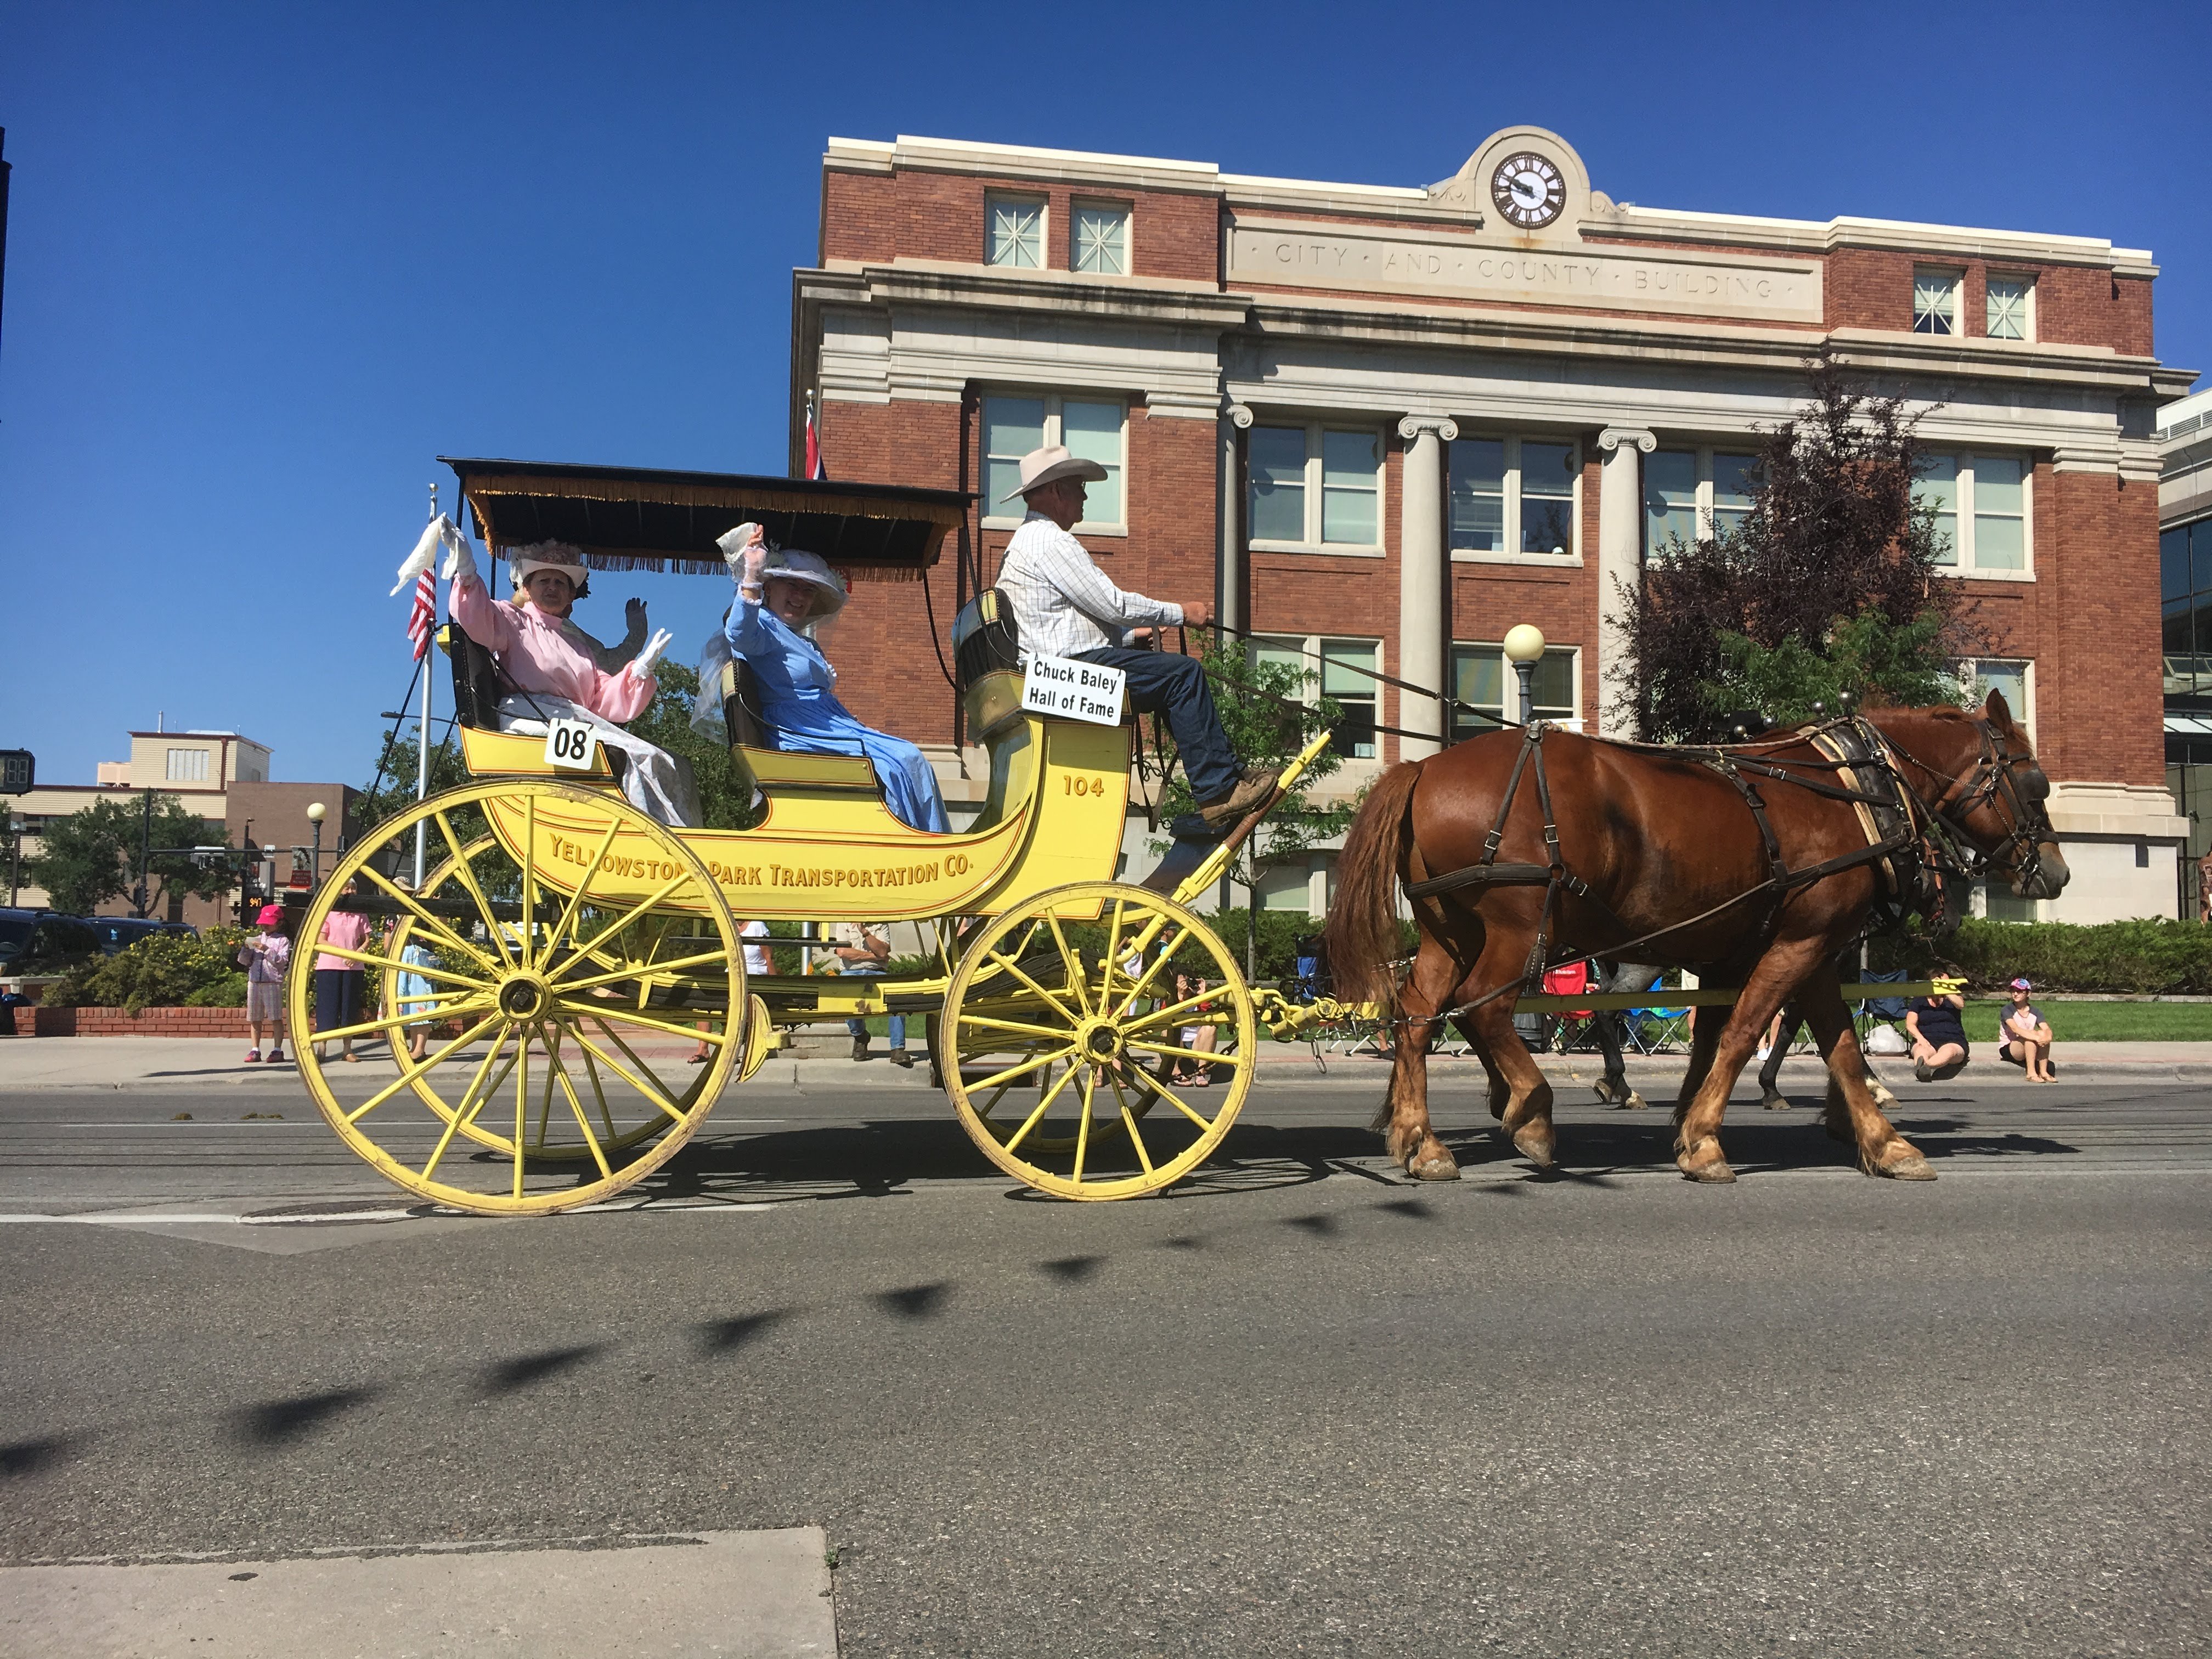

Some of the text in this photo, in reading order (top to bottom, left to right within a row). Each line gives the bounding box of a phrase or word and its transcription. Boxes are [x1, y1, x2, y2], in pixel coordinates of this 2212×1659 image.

[1276, 244, 1772, 298] CITY AND COUNTY BUILDING
[1034, 661, 1118, 695] Chuck Baley
[1029, 687, 1114, 718] Hall of Fame
[554, 727, 588, 761] 08
[1063, 775, 1104, 797] 104
[769, 862, 939, 888] TRANSPORTATION
[944, 854, 974, 877] CO.
